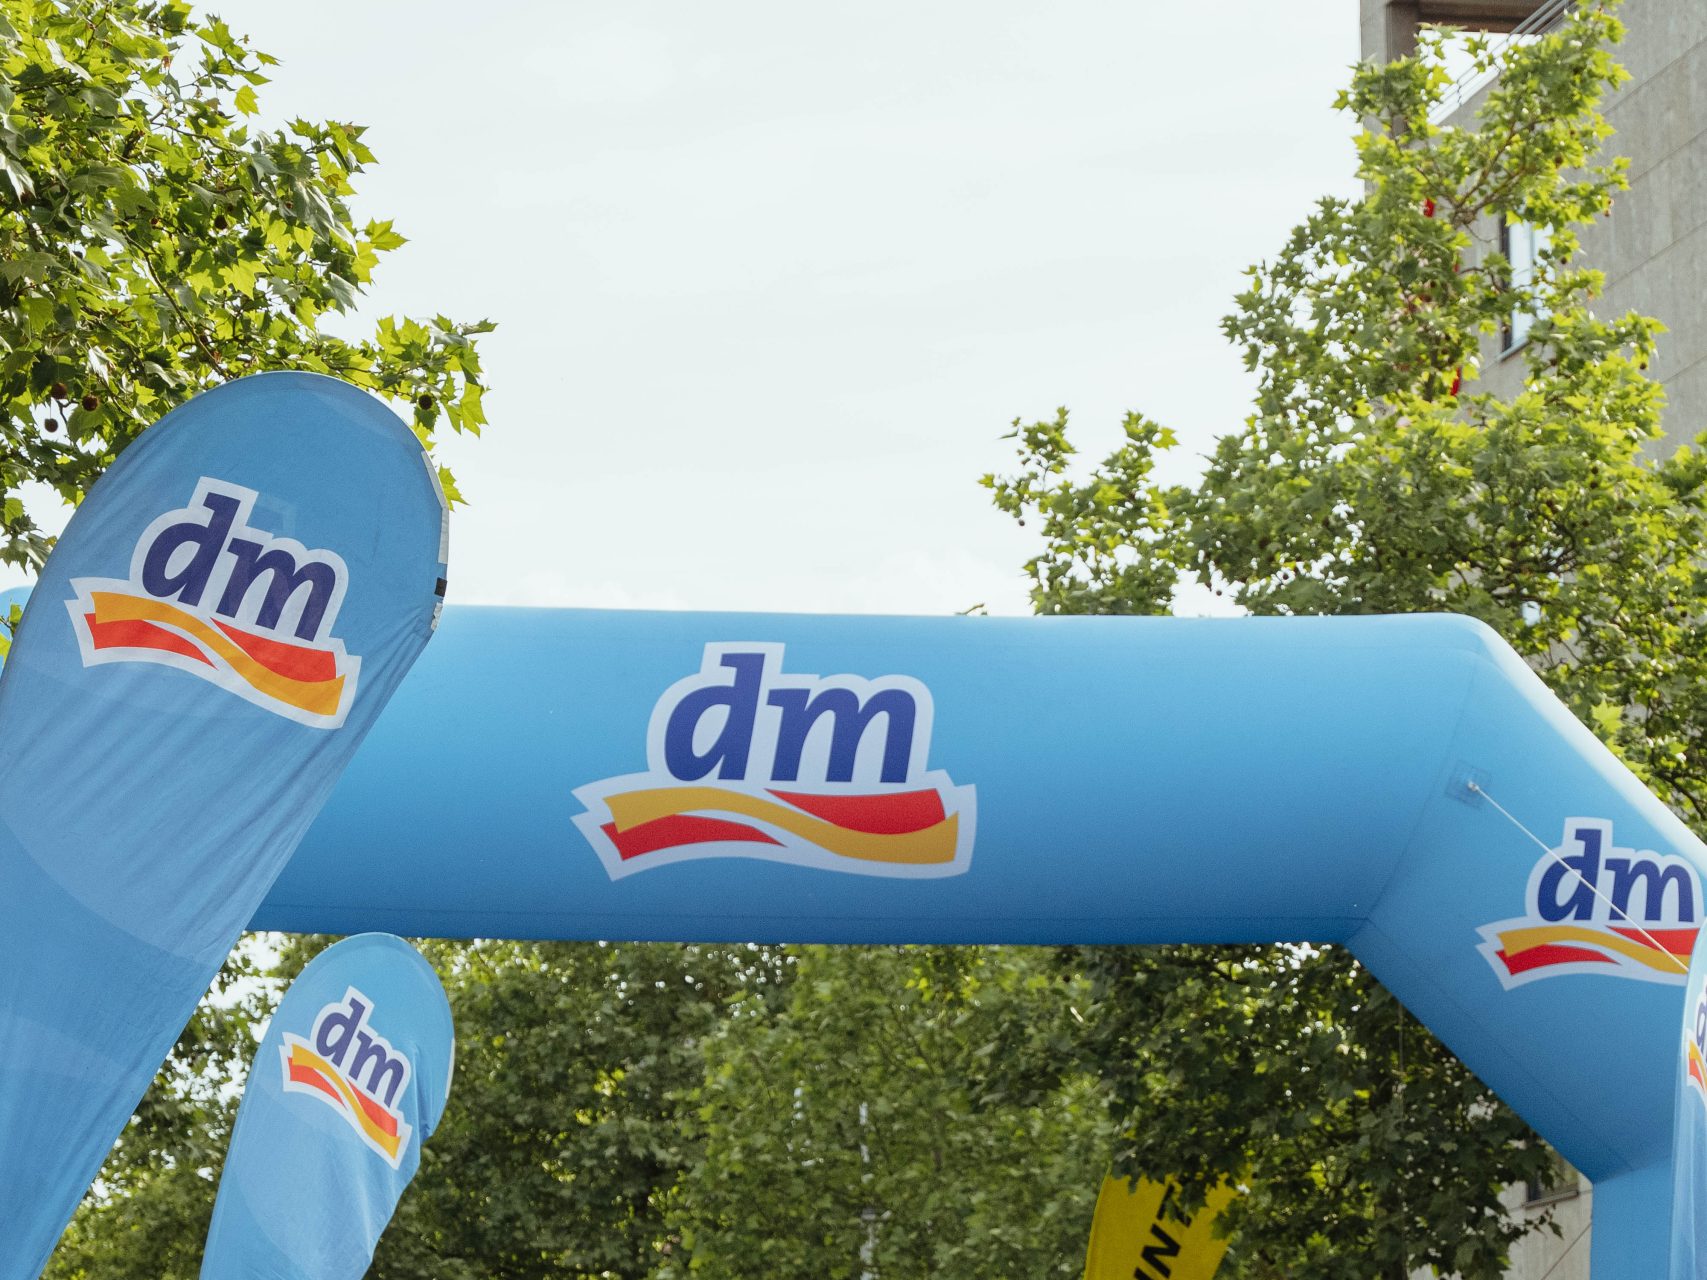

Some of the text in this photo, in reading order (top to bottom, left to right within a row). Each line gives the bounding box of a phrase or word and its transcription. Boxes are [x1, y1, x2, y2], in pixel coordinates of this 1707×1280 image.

[142, 492, 336, 642] dm
[664, 653, 916, 783] dm
[1537, 828, 1695, 922] dm
[316, 997, 404, 1108] dm
